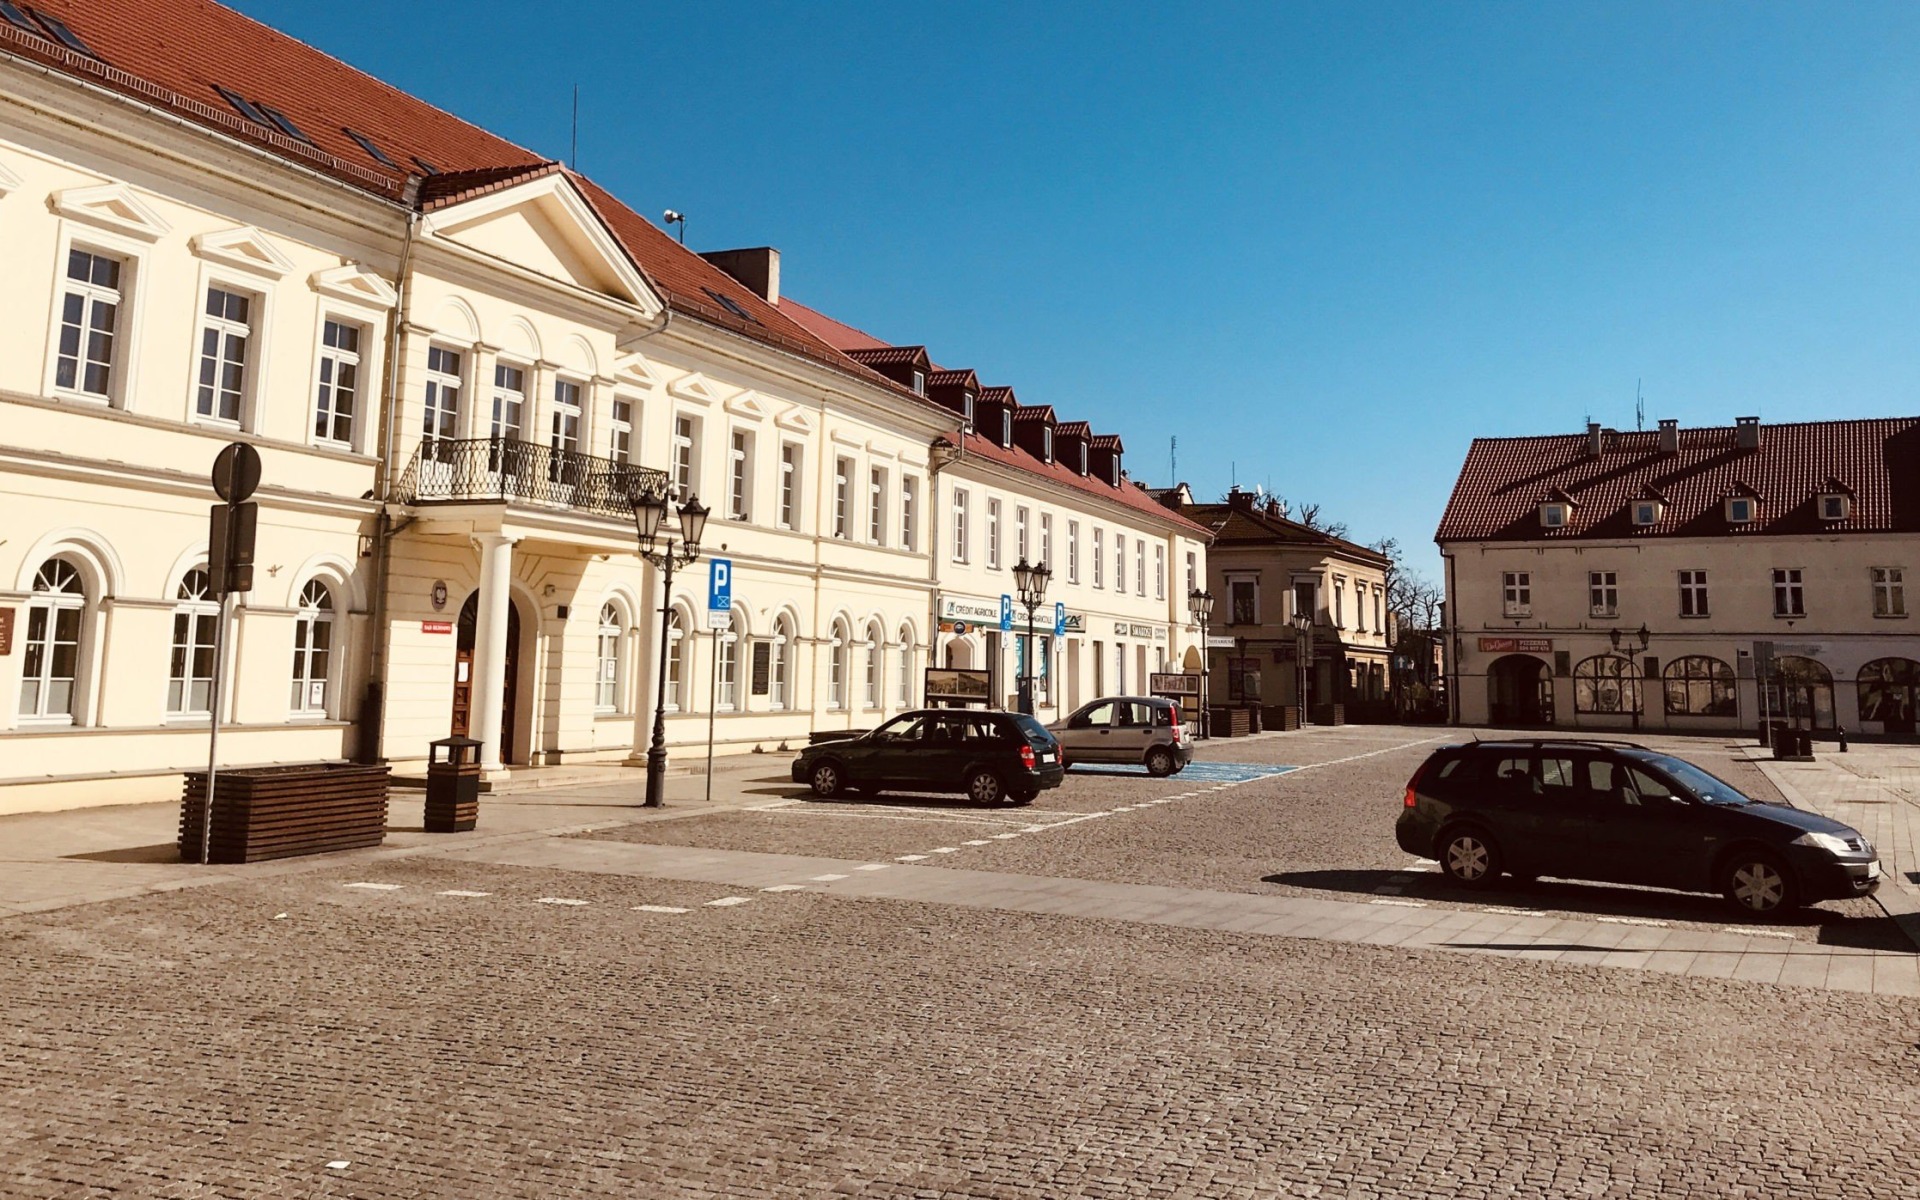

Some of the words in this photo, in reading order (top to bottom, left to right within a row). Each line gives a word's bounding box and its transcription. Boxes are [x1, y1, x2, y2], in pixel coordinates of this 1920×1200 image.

[714, 563, 727, 595] P
[974, 607, 998, 618] AGRICOLE
[1003, 597, 1010, 619] P
[1057, 604, 1063, 626] P
